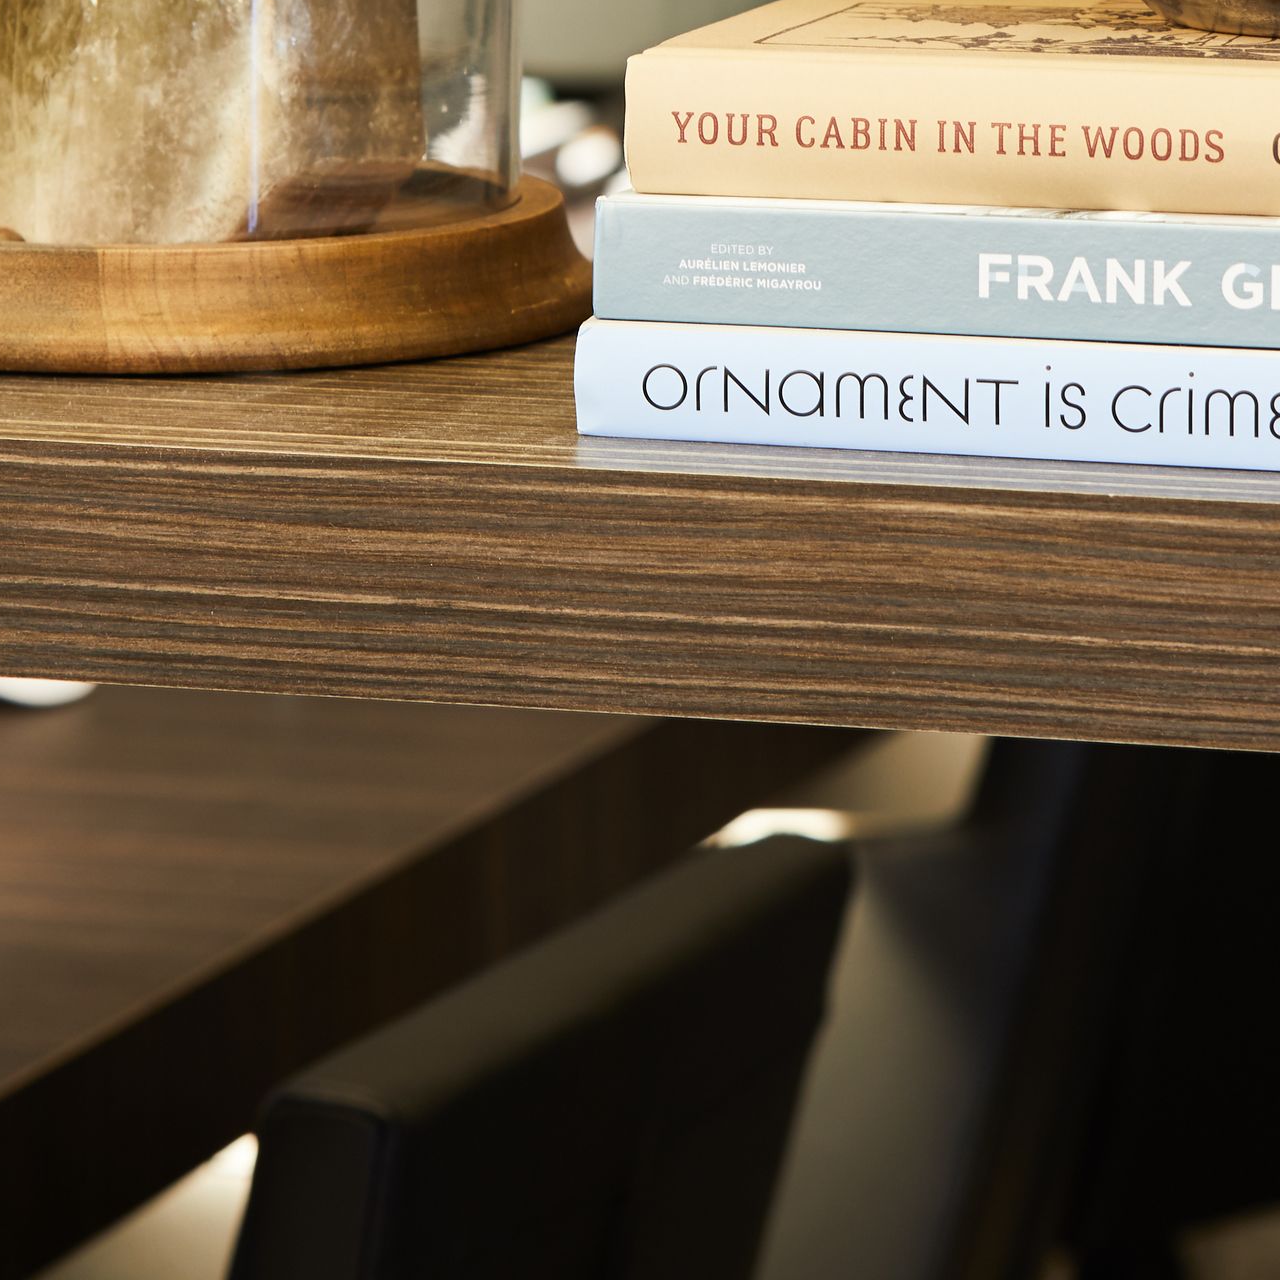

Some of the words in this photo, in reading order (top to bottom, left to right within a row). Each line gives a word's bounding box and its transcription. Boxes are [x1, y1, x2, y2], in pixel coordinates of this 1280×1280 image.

[670, 110, 780, 148] YOUR
[795, 115, 919, 153] CABIN
[936, 119, 976, 154] IN
[991, 122, 1067, 158] THE
[1081, 125, 1225, 164] WOODS
[710, 243, 755, 255] EDITED
[758, 245, 774, 256] BY
[679, 258, 740, 271] AURÉLIEN
[743, 262, 806, 274] LEMONIER
[663, 274, 690, 286] AND
[692, 274, 753, 288] FRÉDÉRIC
[756, 278, 822, 291] MIGAYROU
[977, 252, 1193, 308] FRANK
